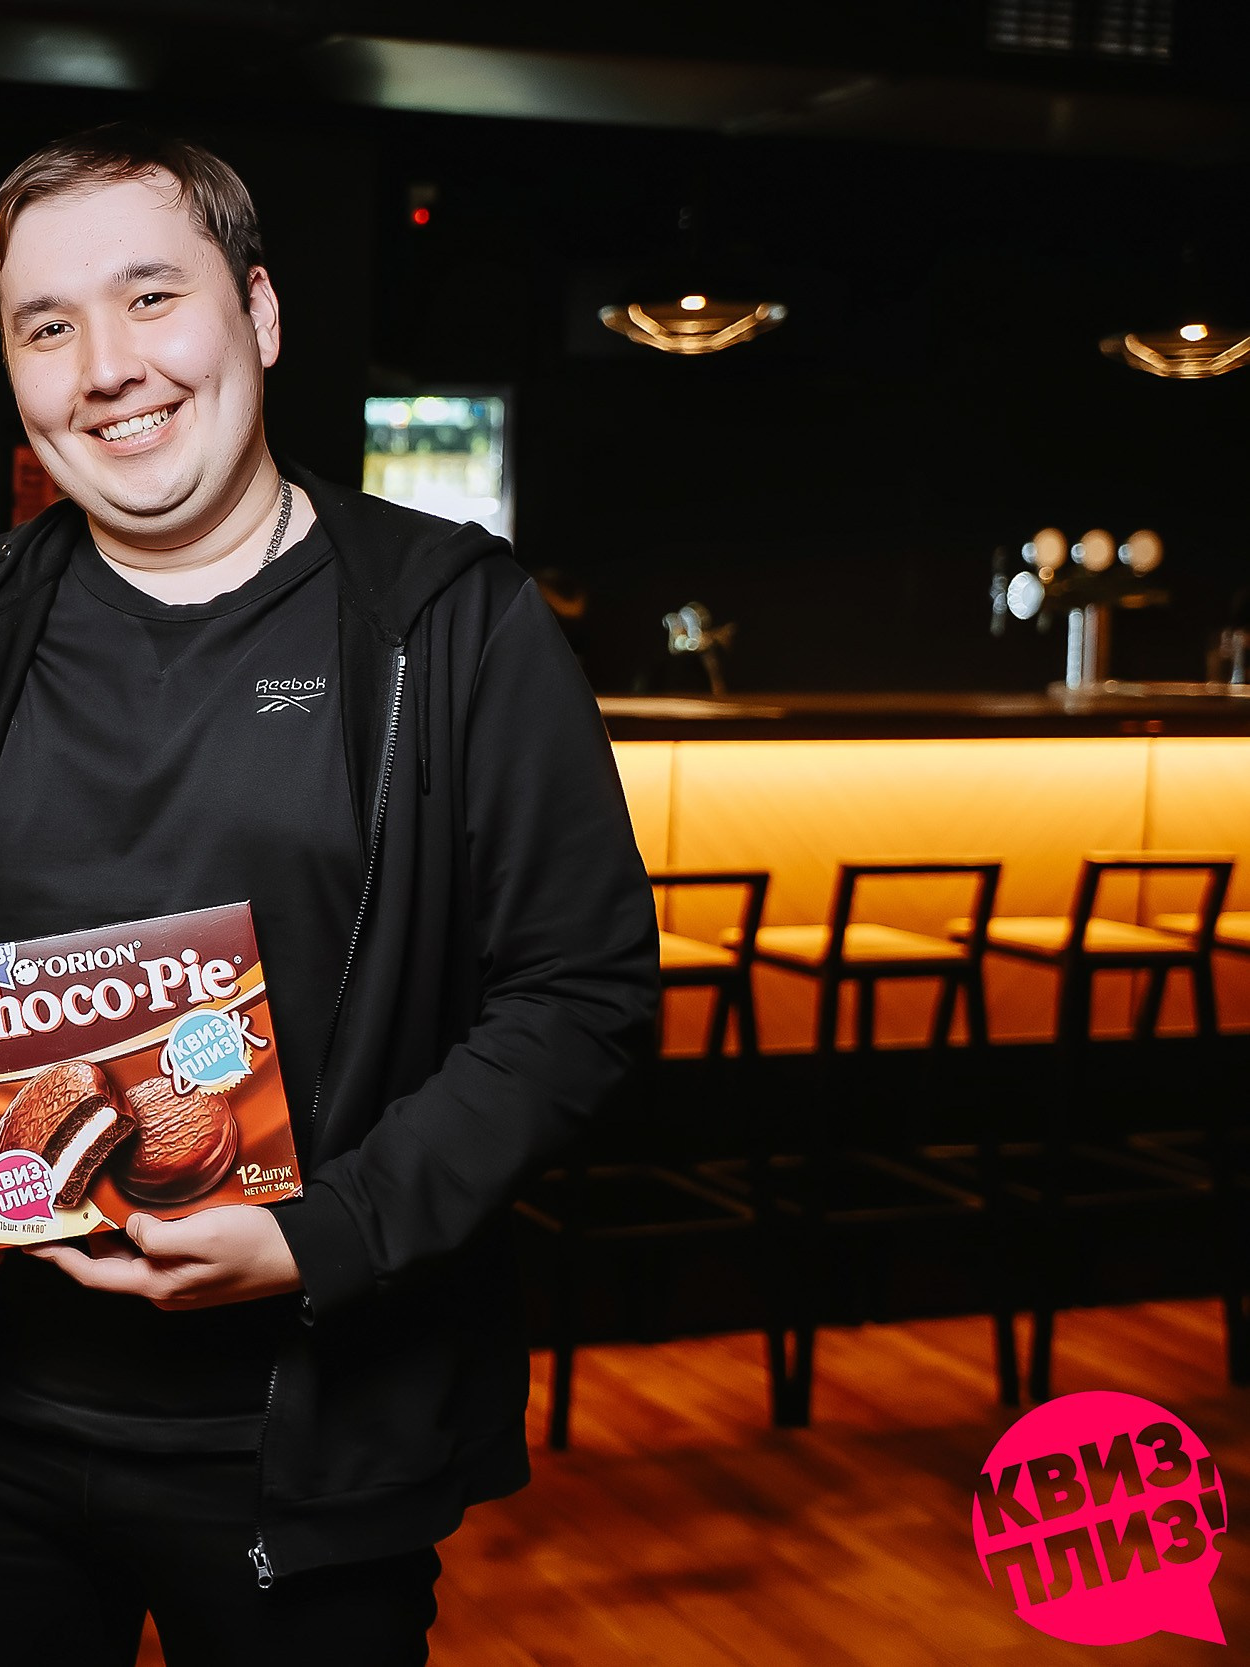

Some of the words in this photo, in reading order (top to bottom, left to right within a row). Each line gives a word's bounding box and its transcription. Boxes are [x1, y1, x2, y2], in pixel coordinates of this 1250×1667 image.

[255, 677, 326, 693] Reebok
[44, 944, 137, 977] ORION
[180, 1032, 240, 1075] ПЛИЗ!
[243, 1186, 259, 1197] NET
[260, 1184, 272, 1194] WT
